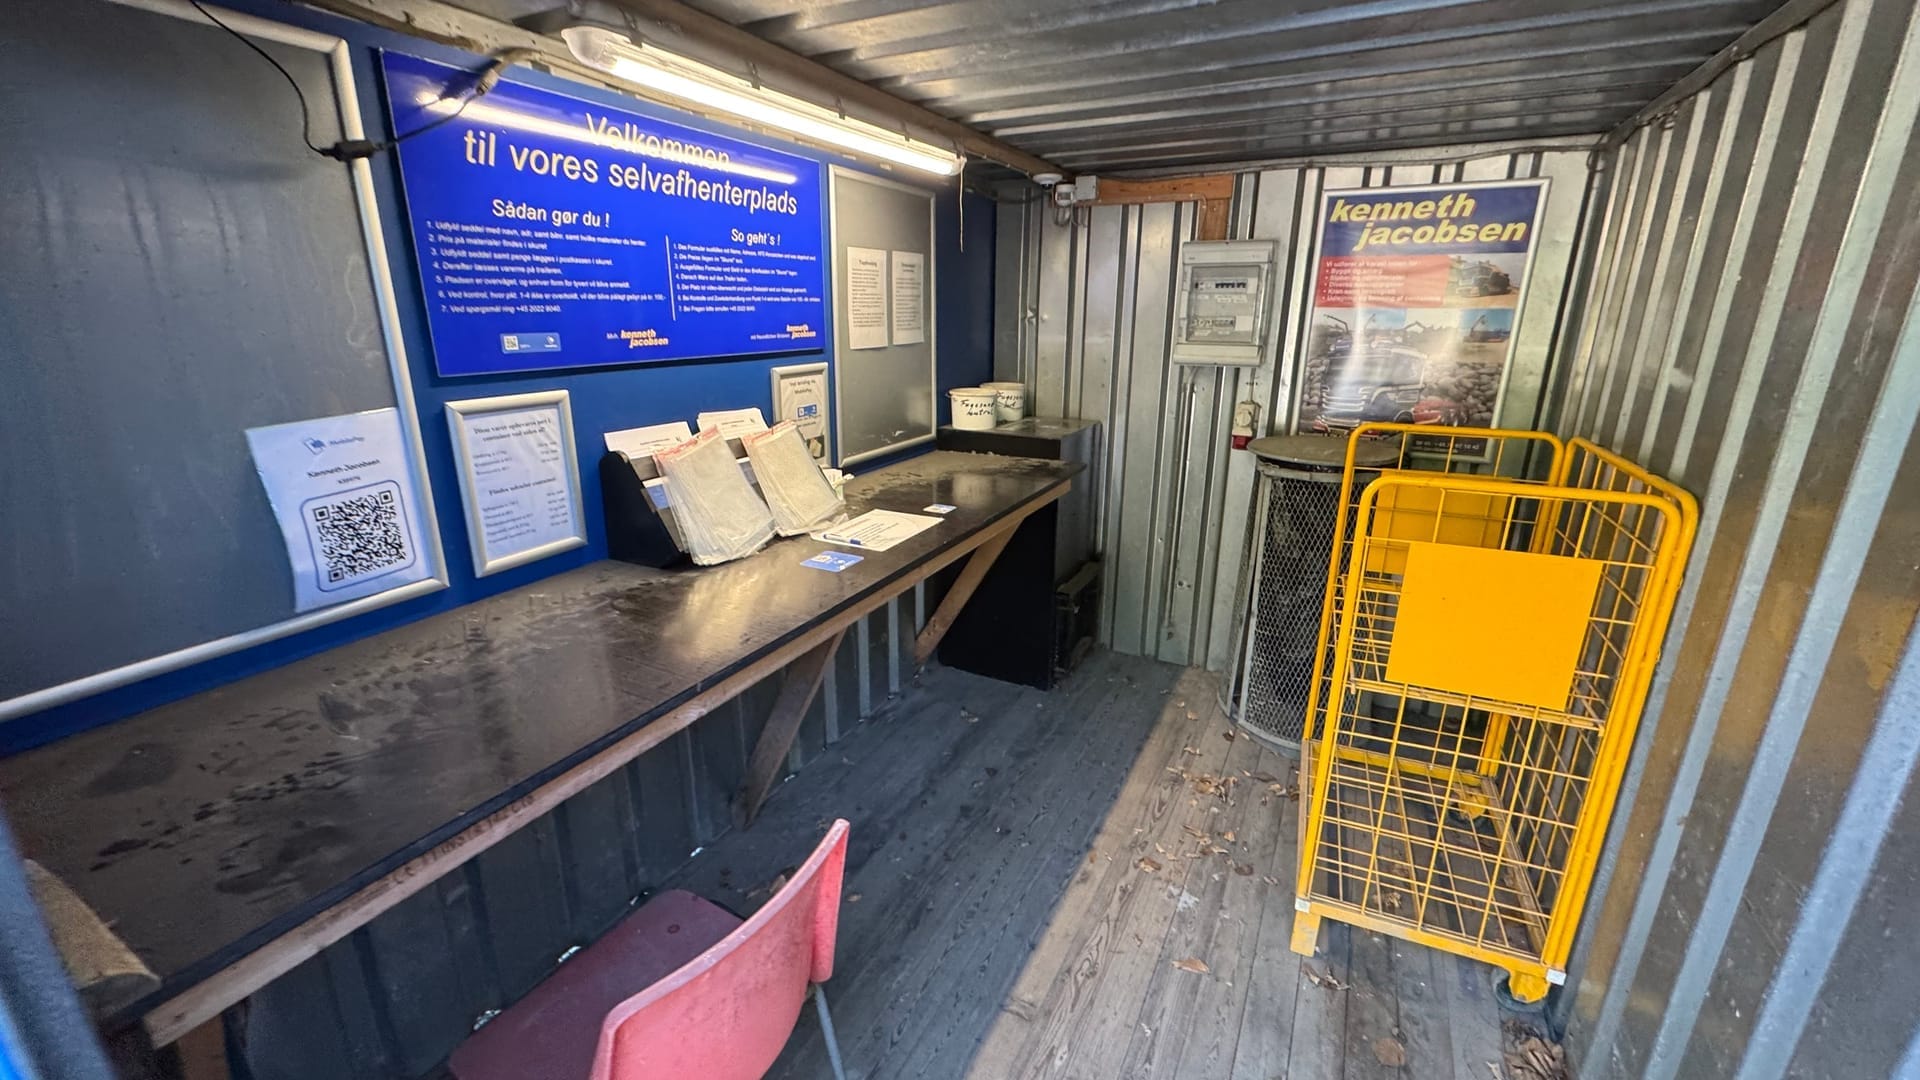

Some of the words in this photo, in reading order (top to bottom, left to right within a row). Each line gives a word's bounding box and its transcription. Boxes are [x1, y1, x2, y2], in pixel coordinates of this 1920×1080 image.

[586, 113, 730, 168] Velkommen
[464, 130, 496, 167] til
[509, 145, 599, 183] vores
[608, 162, 798, 215] selvafhenterplads
[492, 199, 547, 221] Sådan
[552, 210, 578, 227] gør
[582, 211, 600, 227] du
[605, 213, 610, 228] !
[1329, 193, 1476, 223] kenneth
[731, 228, 744, 243] So
[1352, 219, 1528, 252] jacobsen
[621, 329, 657, 341] kenneth
[629, 337, 669, 349] jacobsen
